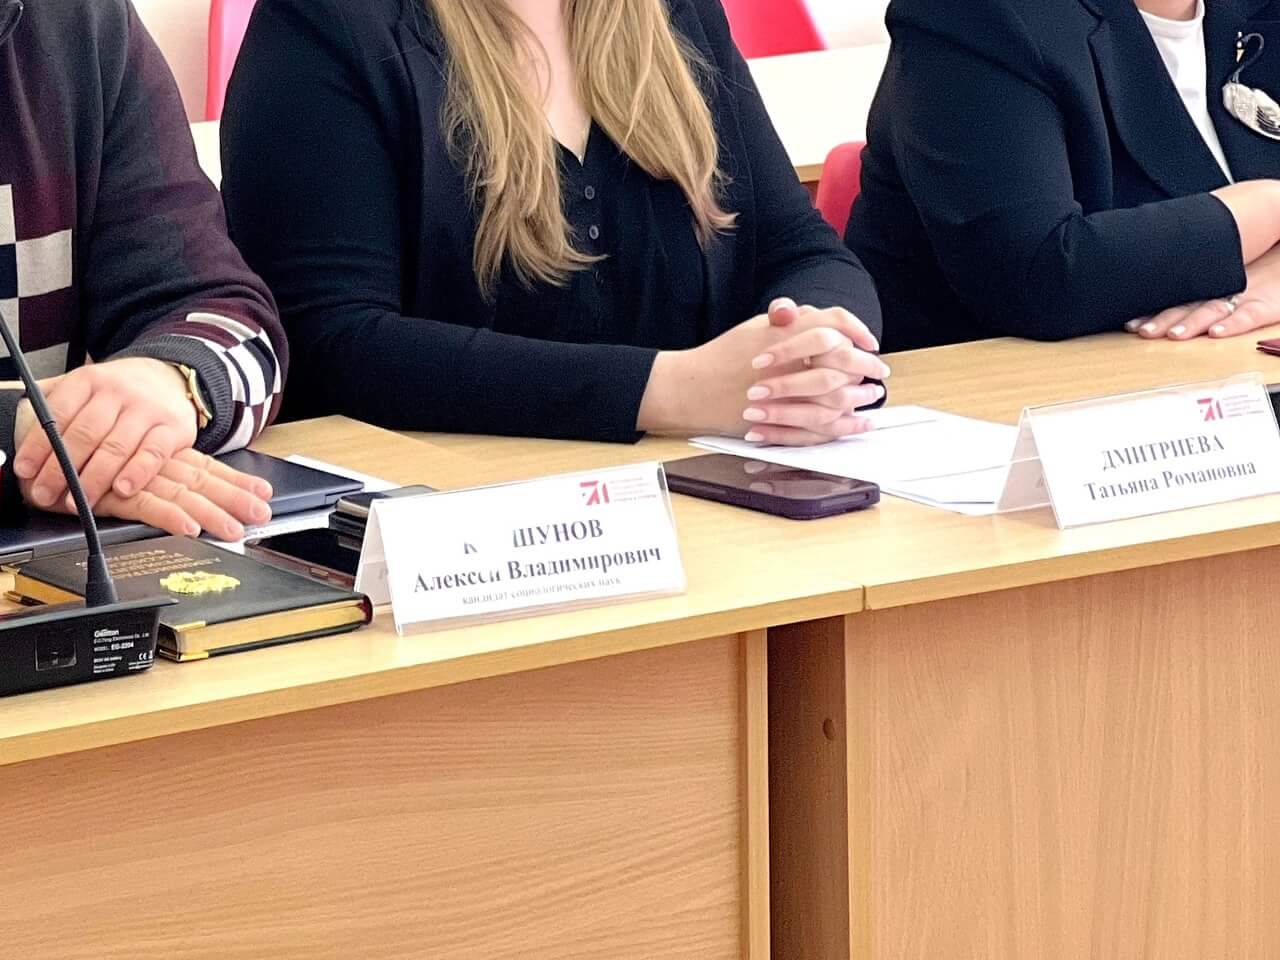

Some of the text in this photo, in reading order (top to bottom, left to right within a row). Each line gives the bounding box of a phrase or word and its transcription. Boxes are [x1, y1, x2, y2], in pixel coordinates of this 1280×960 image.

[1102, 434, 1225, 471] ДМИТРИЕВА
[1084, 461, 1257, 500] Татьяна Романовна
[507, 547, 662, 581] Владимирович
